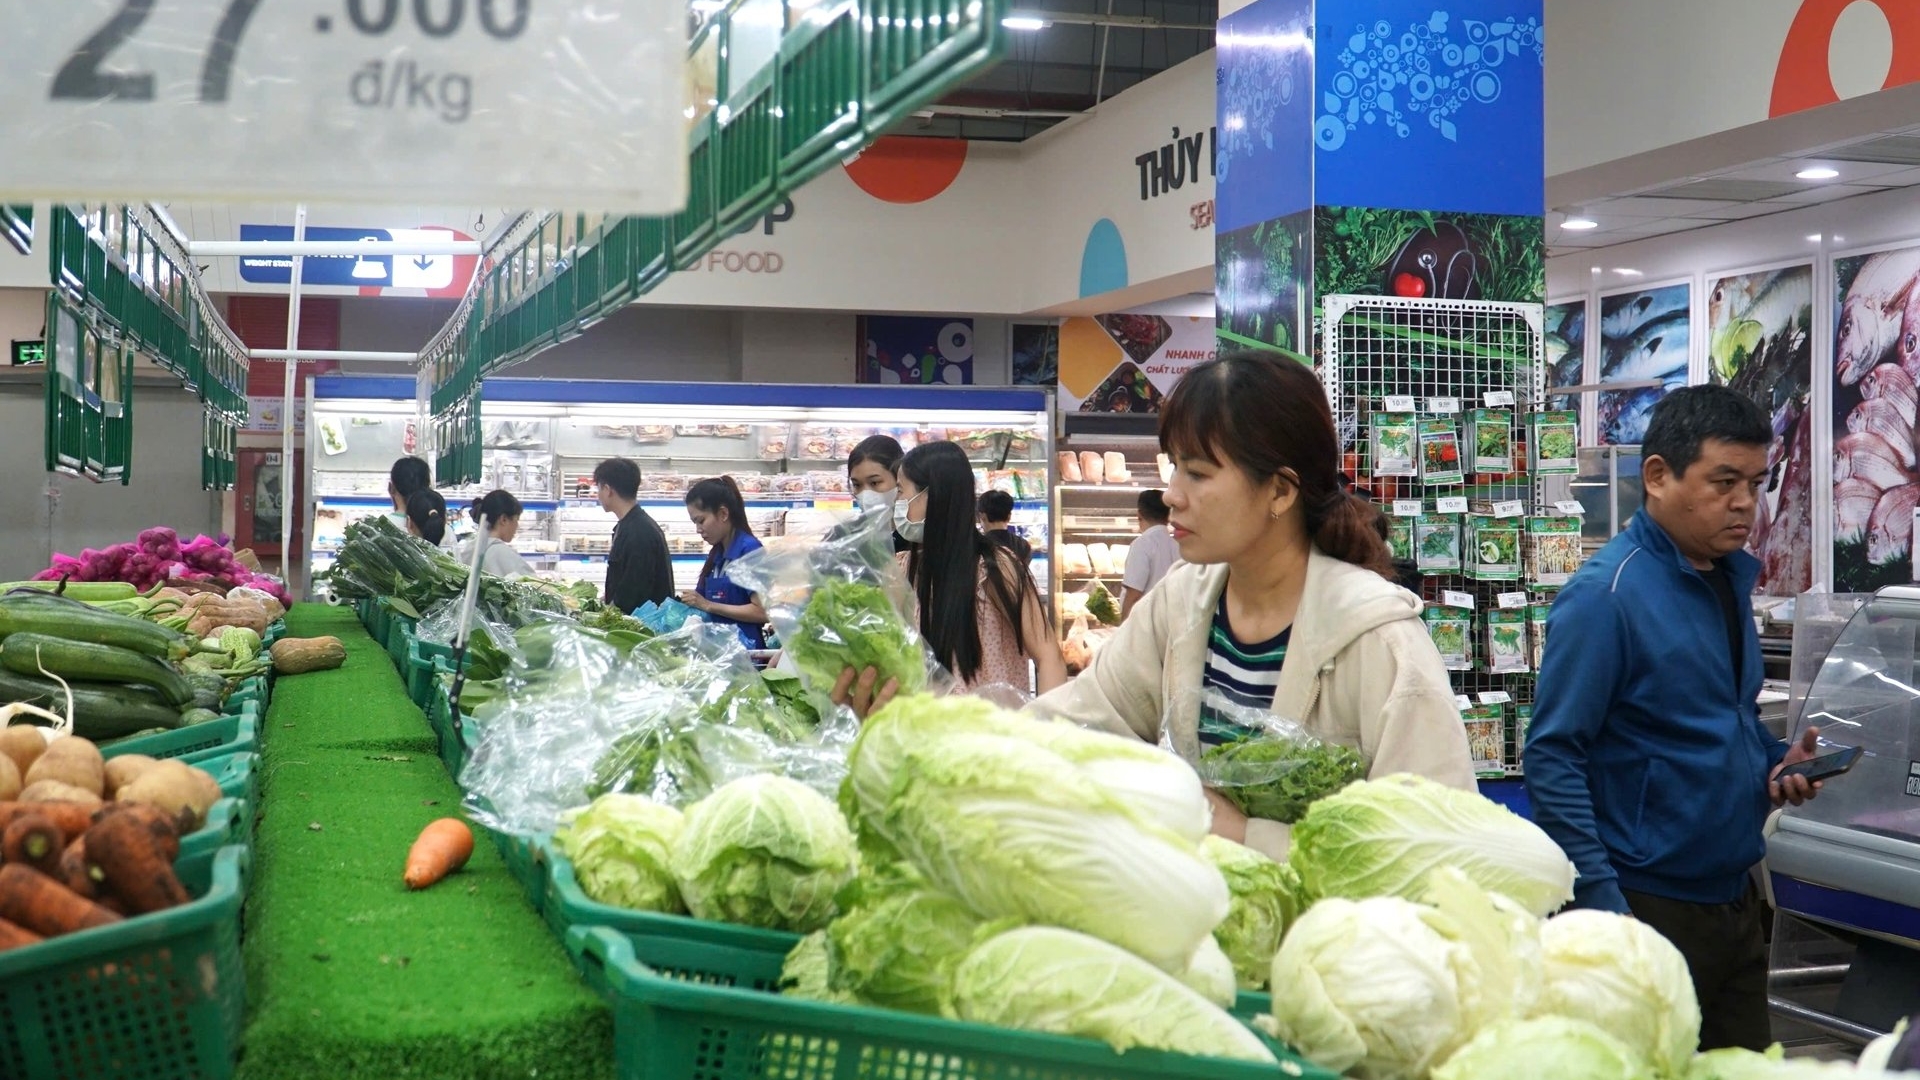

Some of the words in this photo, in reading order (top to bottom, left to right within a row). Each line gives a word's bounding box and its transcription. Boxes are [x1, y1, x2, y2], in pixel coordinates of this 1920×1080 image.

[350, 60, 474, 123] đ/kg
[1135, 126, 1204, 201] THỦY
[708, 251, 784, 274] FOOD
[1165, 350, 1205, 360] NHANH
